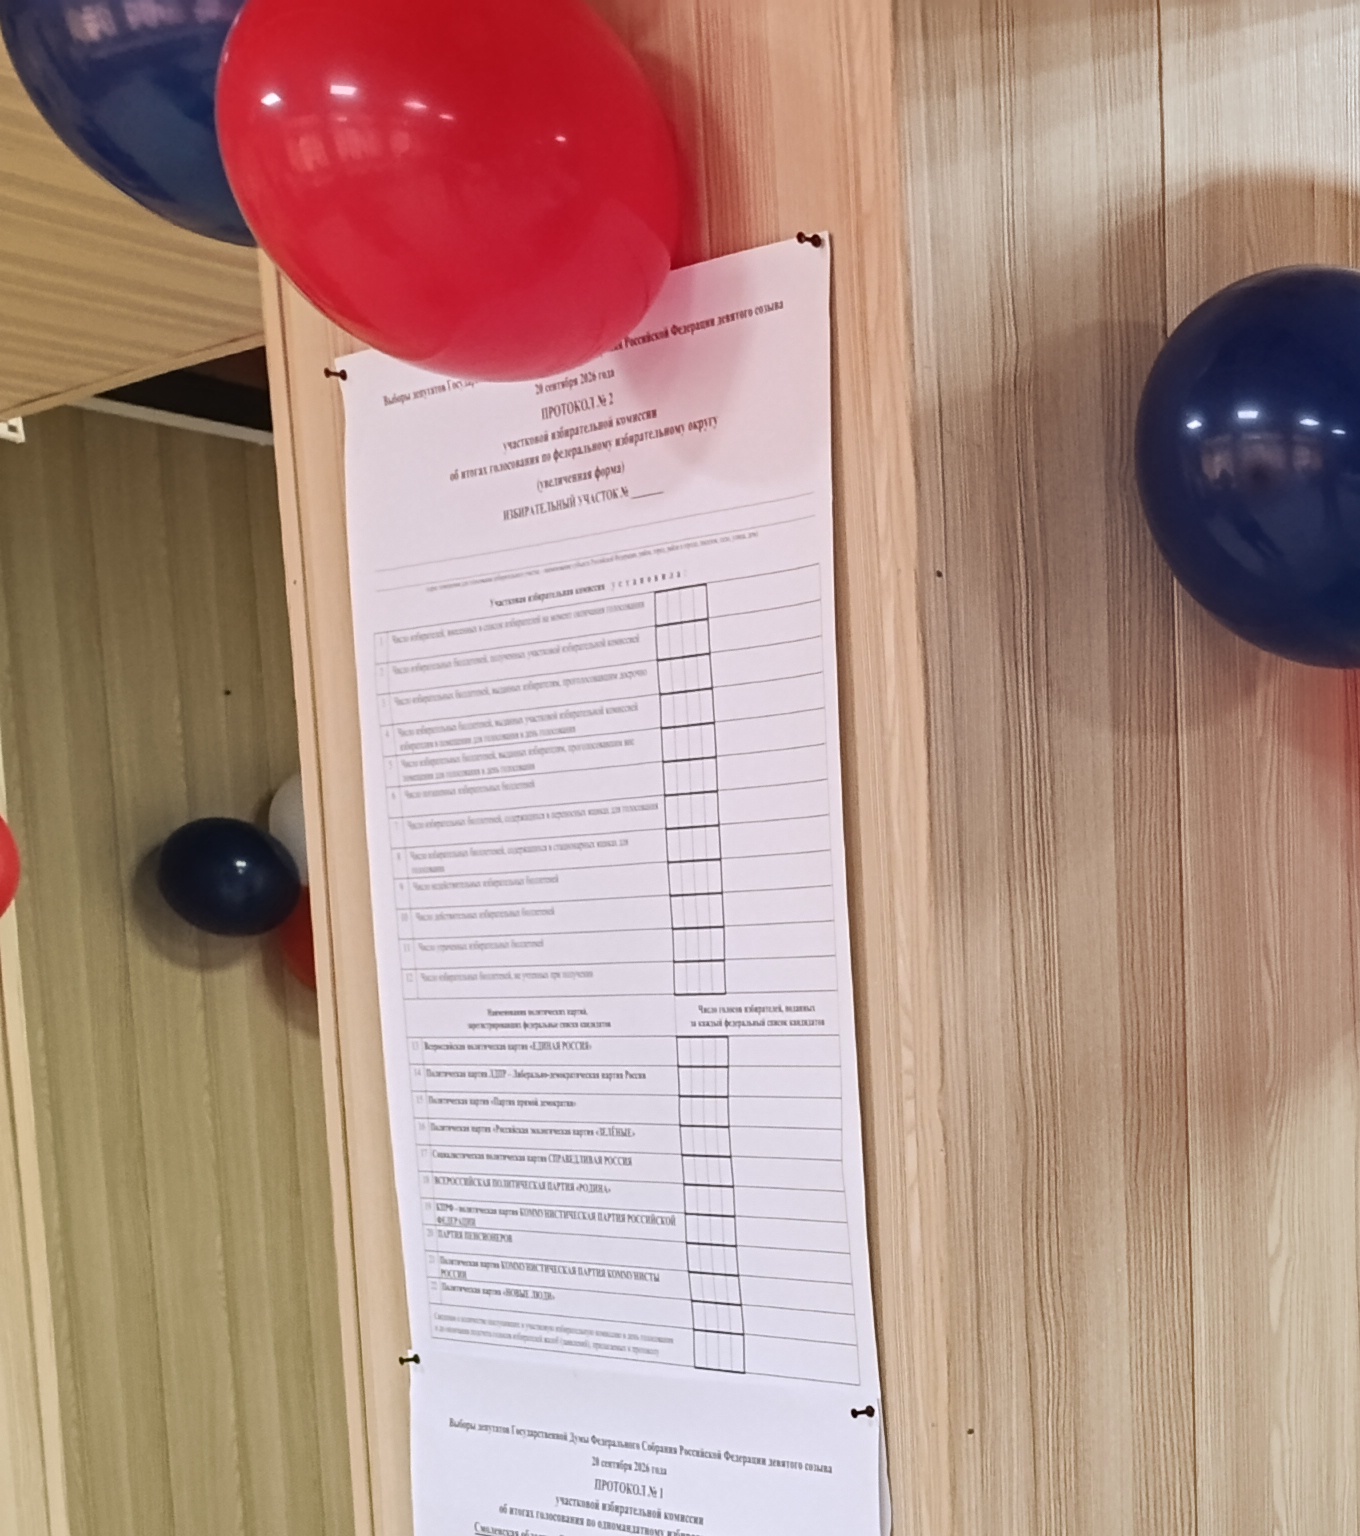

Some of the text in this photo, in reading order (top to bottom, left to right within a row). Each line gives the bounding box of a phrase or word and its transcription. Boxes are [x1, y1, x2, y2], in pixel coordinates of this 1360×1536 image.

[608, 391, 613, 406] 2
[594, 1478, 646, 1497] ПРОТОКОЛ
[659, 1487, 663, 1500] 1
[498, 1503, 507, 1515] об
[586, 1517, 595, 1528] по
[555, 1496, 703, 1526] участковой избирательной комиссии
